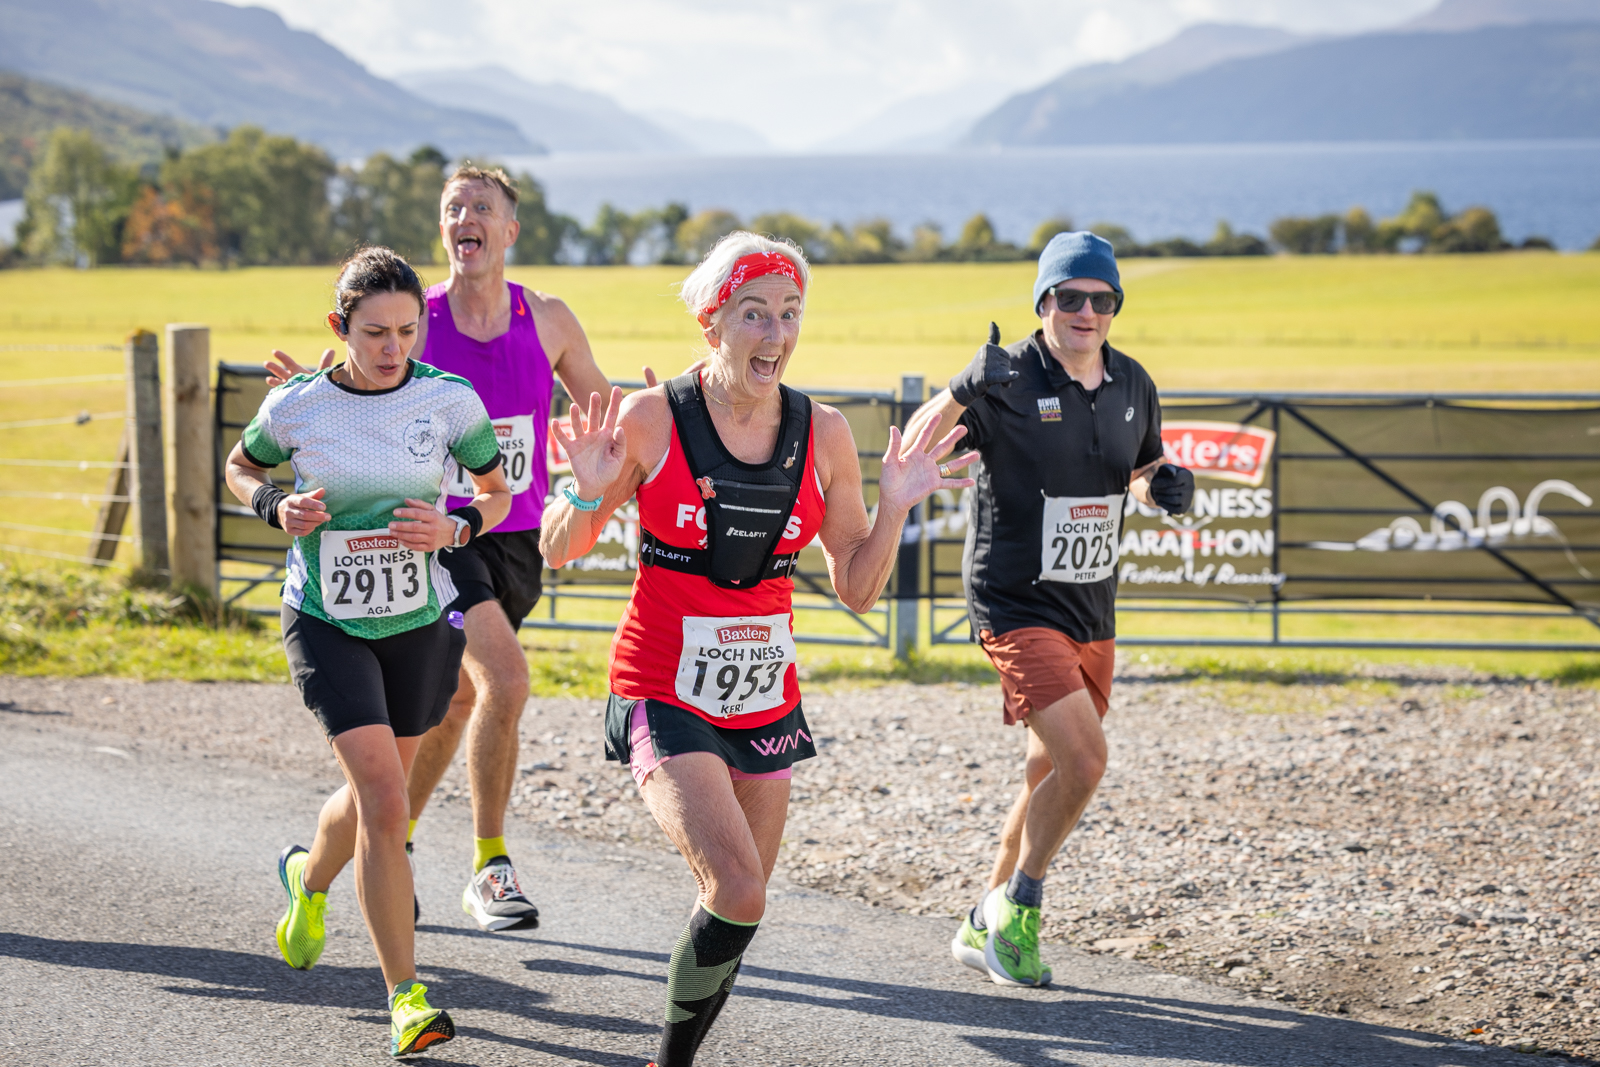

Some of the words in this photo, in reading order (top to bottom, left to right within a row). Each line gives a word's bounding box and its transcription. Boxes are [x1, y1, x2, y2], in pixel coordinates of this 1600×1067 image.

[1163, 432, 1258, 472] xters
[1194, 487, 1273, 519] NESS
[1072, 506, 1109, 519] Baxters
[732, 530, 767, 538] ZELAFIT
[1056, 523, 1090, 534] LOCH
[1093, 519, 1114, 533] NESS
[349, 537, 398, 552] Baxters
[1119, 528, 1275, 558] ARATHON
[334, 554, 374, 568] LOCH
[379, 549, 415, 565] NESS
[1051, 532, 1113, 571] 2025
[1074, 571, 1097, 580] PETER
[331, 562, 420, 606] 2913
[367, 605, 392, 615] AGA
[720, 626, 769, 643] Baxters
[698, 646, 745, 661] LOCH
[750, 645, 785, 661] NESS
[692, 659, 783, 702] 1953
[720, 703, 744, 714] KERI
